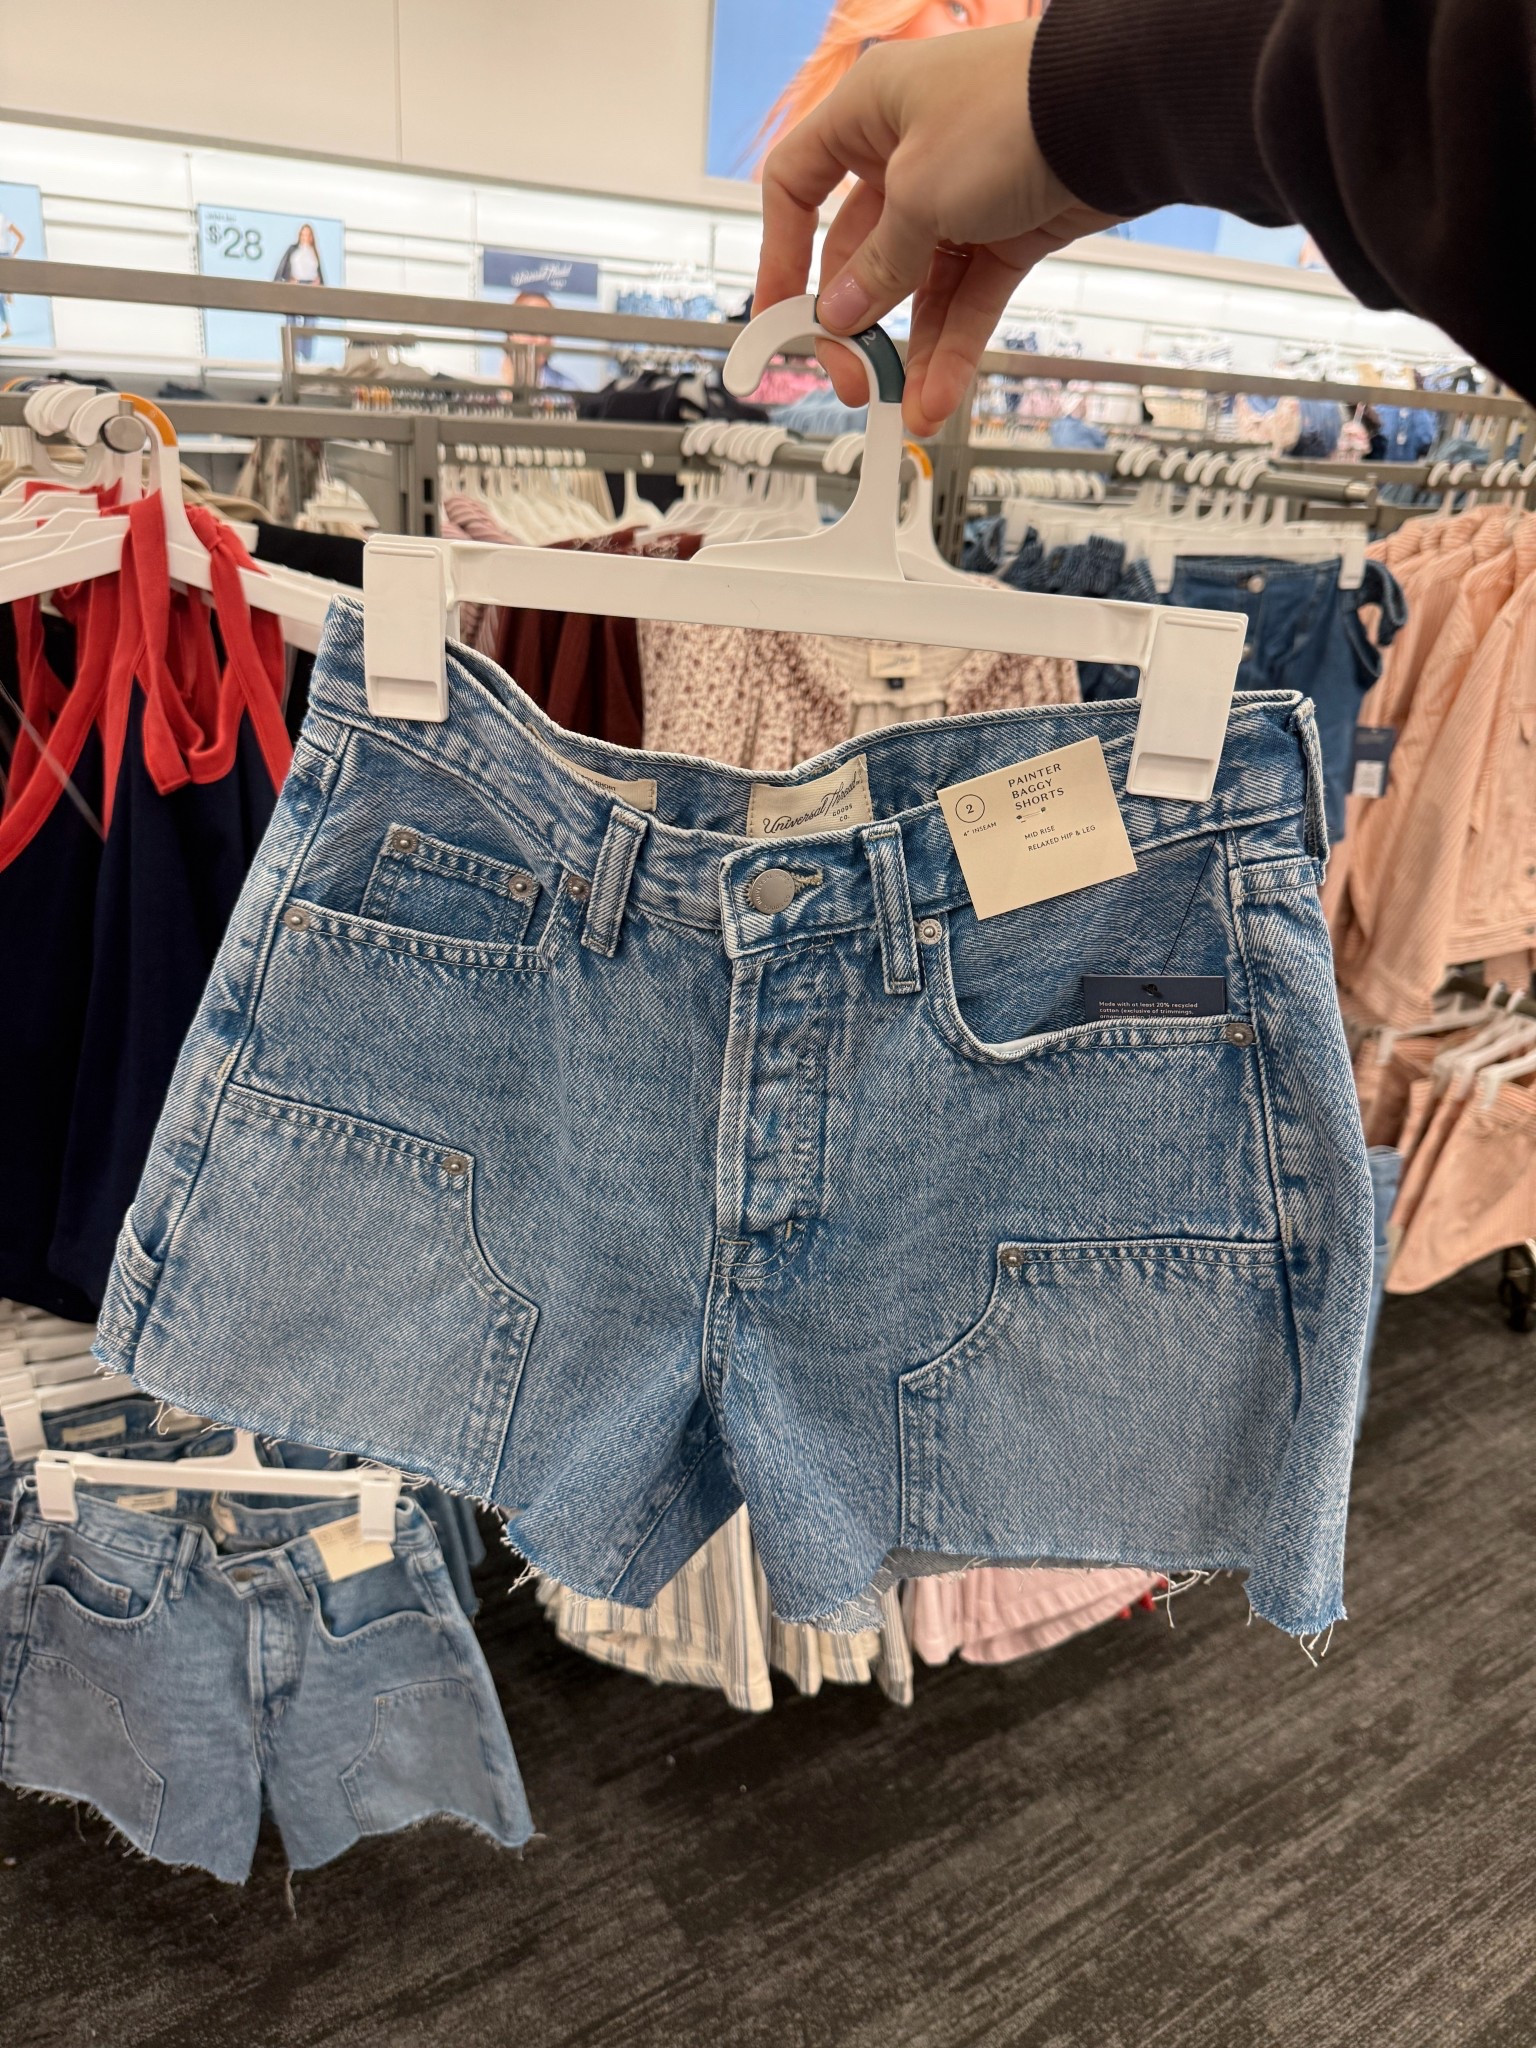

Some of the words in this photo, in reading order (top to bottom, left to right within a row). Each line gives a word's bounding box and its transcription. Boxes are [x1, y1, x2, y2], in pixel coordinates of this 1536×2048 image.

[208, 225, 263, 261] $28
[1008, 763, 1062, 788] PAINTER
[1011, 778, 1053, 799] BAGGY
[1015, 787, 1065, 811] SHORTS
[762, 797, 829, 834] Universal
[821, 771, 857, 817] Thread
[832, 803, 853, 817] GOODS
[965, 804, 975, 814] 2
[972, 822, 997, 834] INSEAM
[1024, 832, 1039, 841] MID
[1039, 825, 1056, 836] RISE
[1028, 837, 1060, 852] RELAXED
[1061, 831, 1073, 841] HIP
[1082, 825, 1096, 834] LEG
